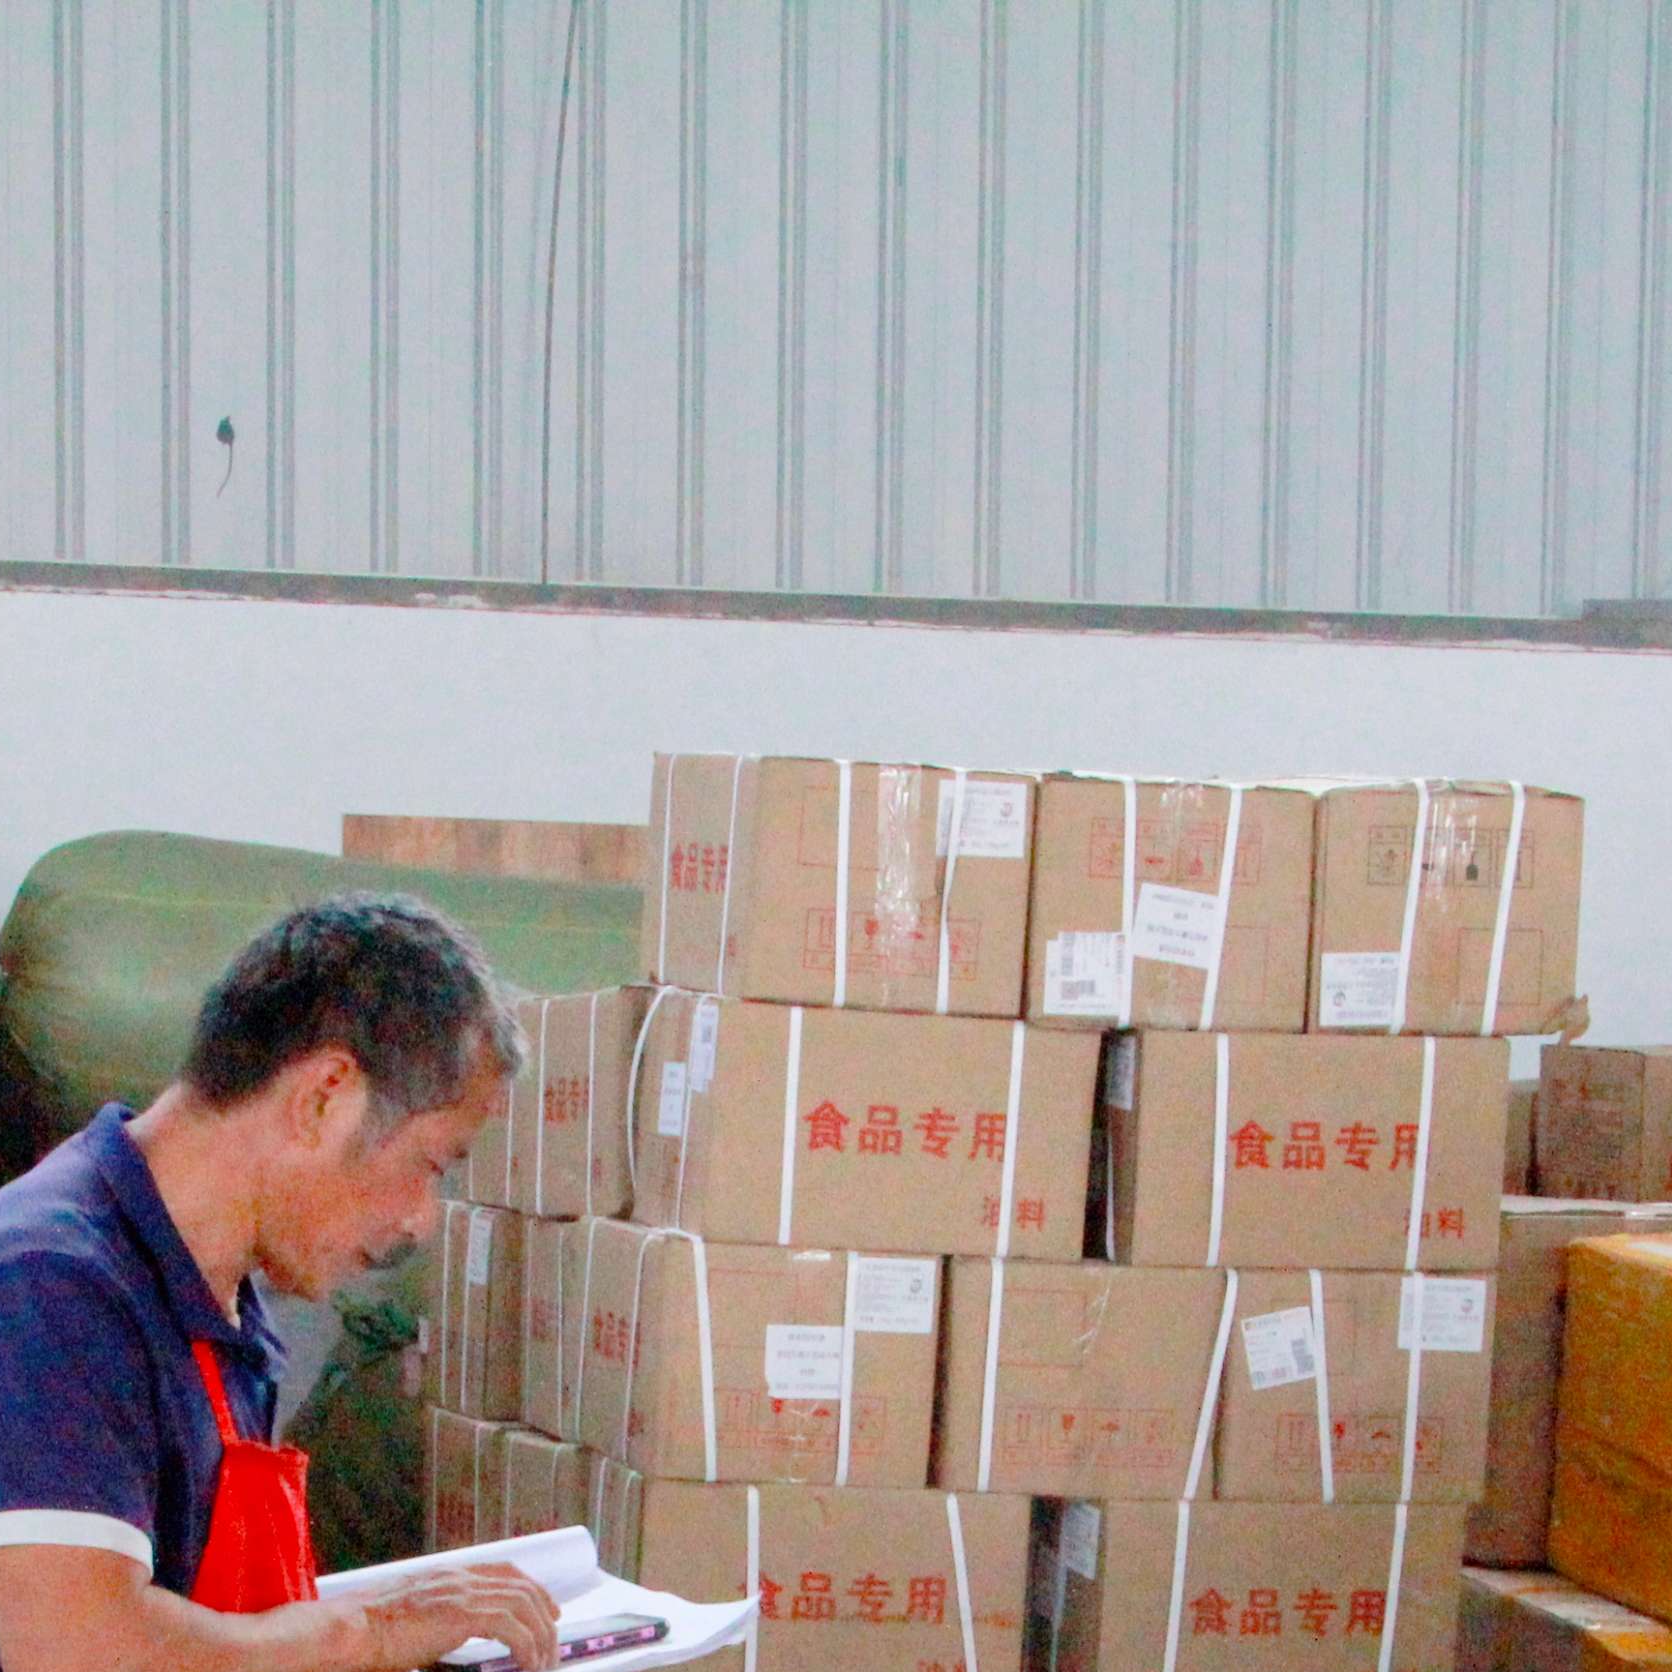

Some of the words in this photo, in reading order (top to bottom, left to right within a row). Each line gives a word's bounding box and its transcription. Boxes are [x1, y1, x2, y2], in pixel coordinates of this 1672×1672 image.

[804, 1101, 1008, 1163] 食品专用
[1227, 1119, 1421, 1172] 食品专用
[739, 1572, 948, 1625] 食品专用
[1189, 1586, 1390, 1638] 食品专用
